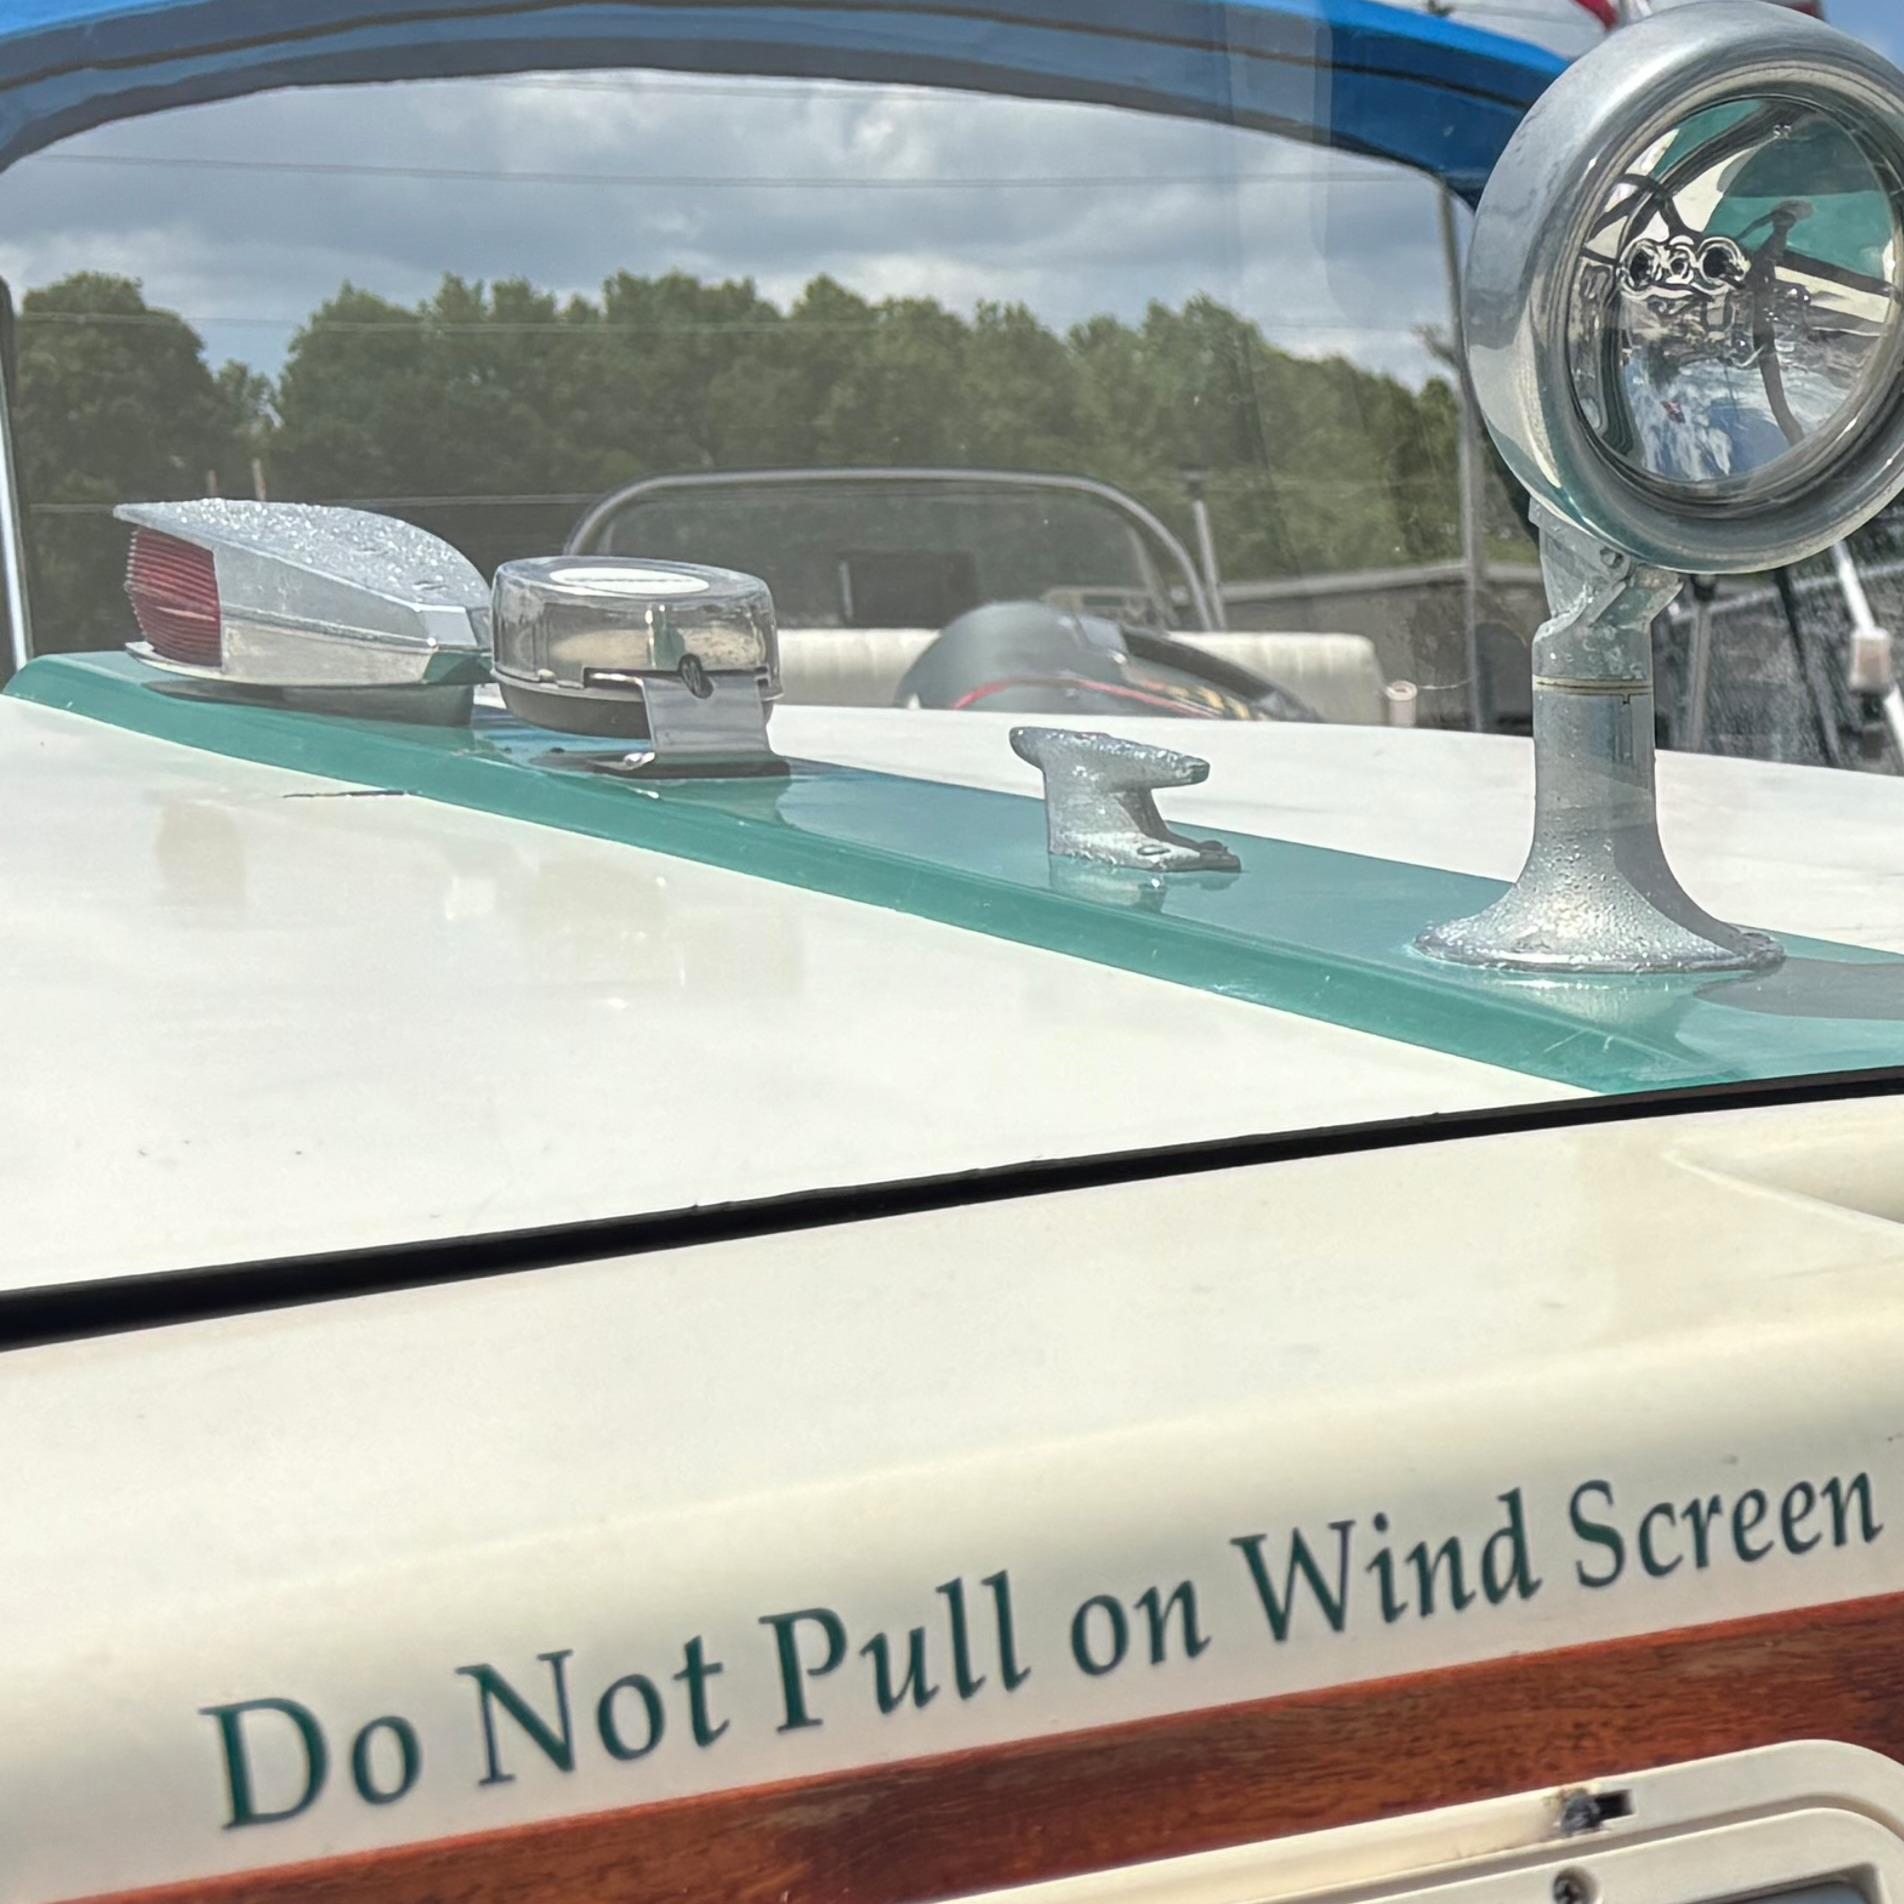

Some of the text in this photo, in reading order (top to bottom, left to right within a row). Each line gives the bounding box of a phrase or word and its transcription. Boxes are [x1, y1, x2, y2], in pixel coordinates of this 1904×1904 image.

[199, 1472, 1884, 1831] Do Not Pull on Wind Screen
